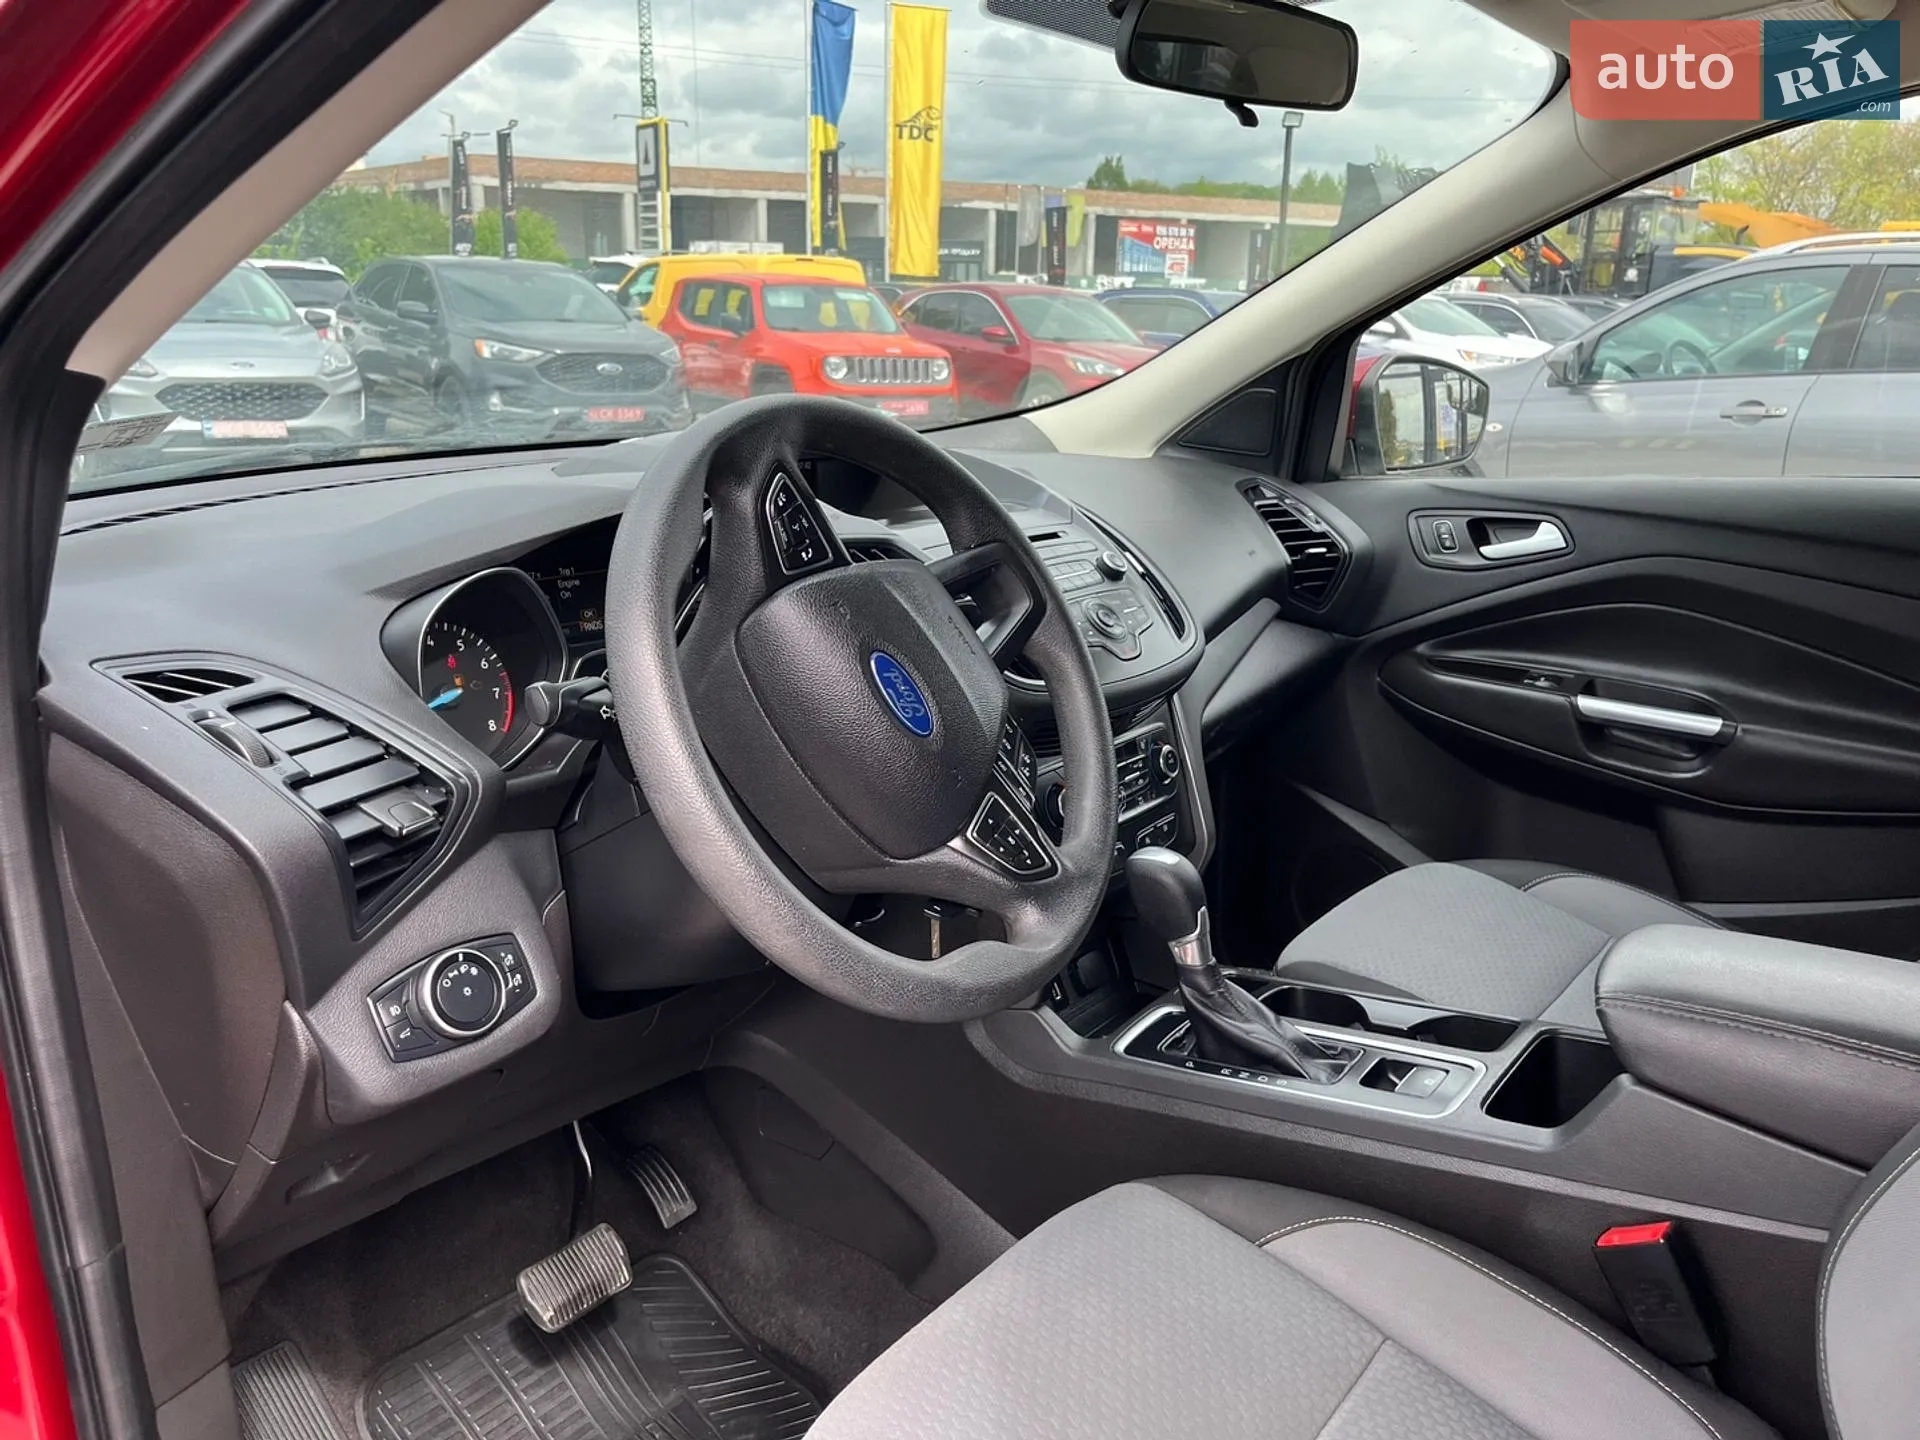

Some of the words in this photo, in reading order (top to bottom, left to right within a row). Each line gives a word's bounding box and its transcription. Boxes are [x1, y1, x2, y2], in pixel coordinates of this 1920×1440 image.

[895, 124, 934, 142] TDC
[1153, 236, 1195, 250] ОРЕНДА
[557, 578, 580, 589] Engine
[560, 590, 572, 599] On
[426, 635, 435, 647] 4
[456, 639, 465, 652] 5
[480, 657, 490, 670] 6
[492, 686, 500, 700] 7
[883, 668, 925, 717] Ford
[487, 719, 498, 732] 8
[1220, 1067, 1232, 1076] R
[1257, 1074, 1269, 1083] D
